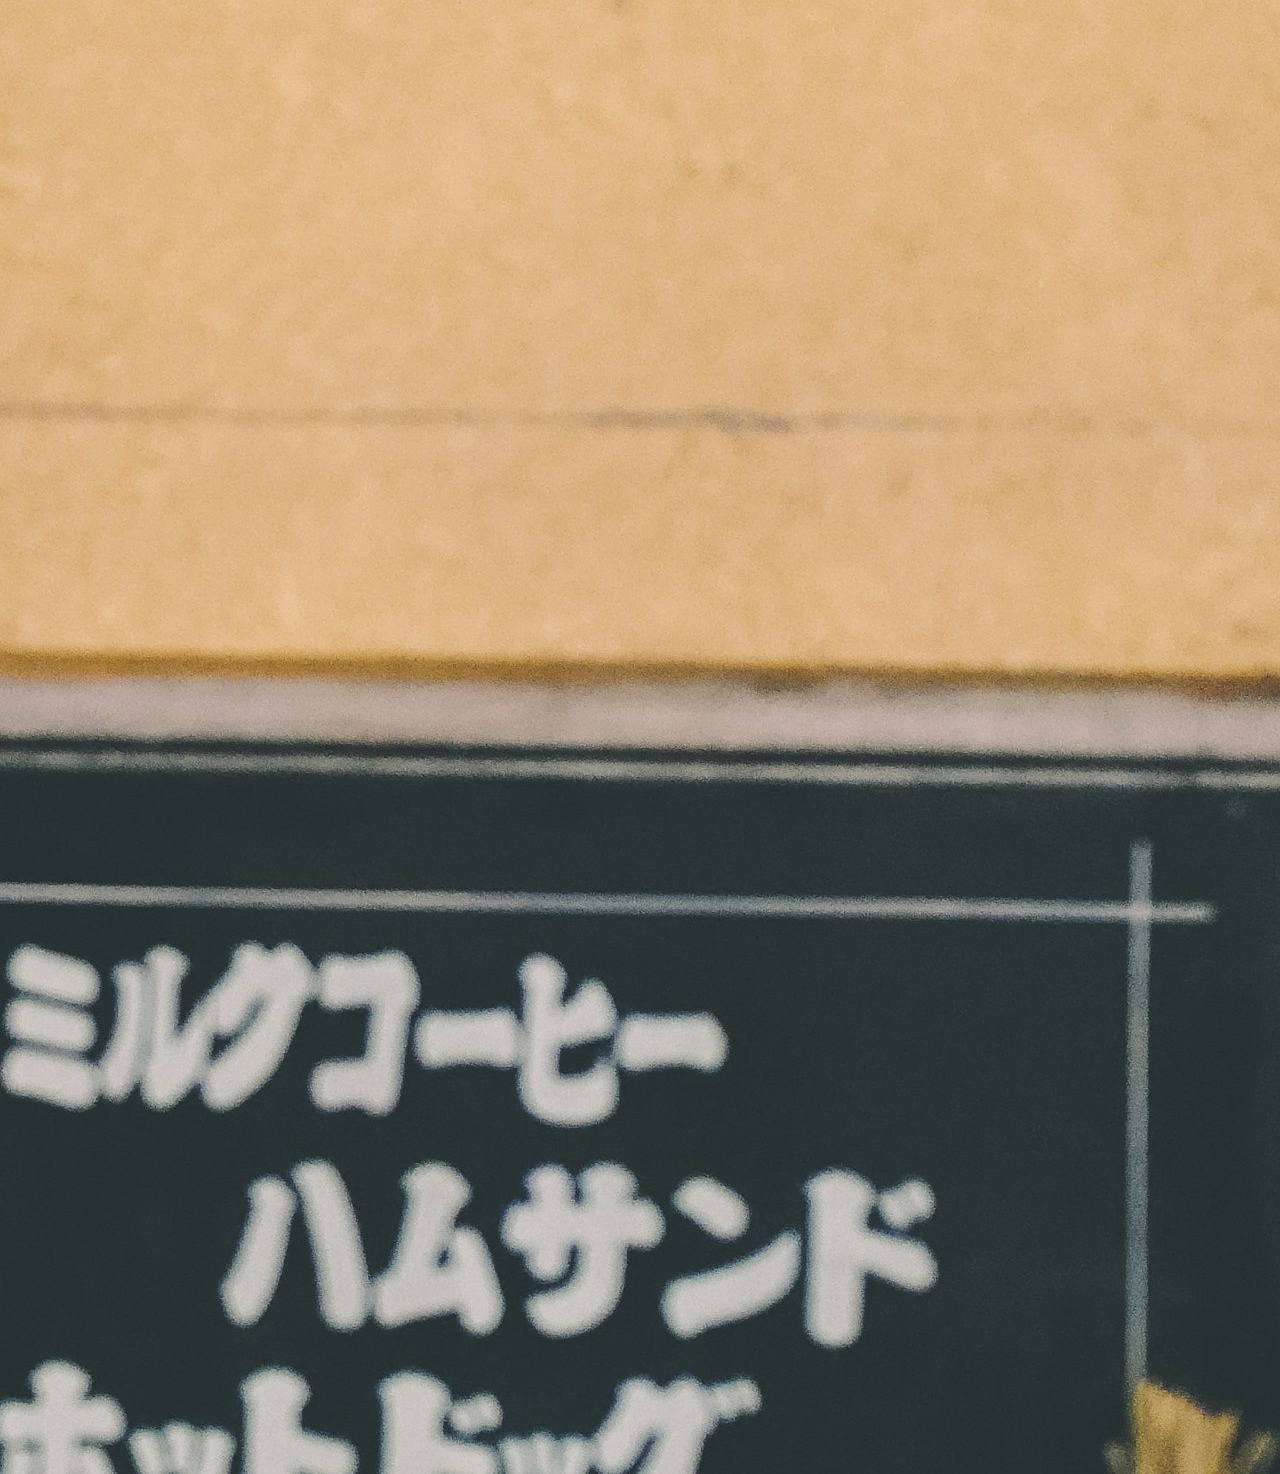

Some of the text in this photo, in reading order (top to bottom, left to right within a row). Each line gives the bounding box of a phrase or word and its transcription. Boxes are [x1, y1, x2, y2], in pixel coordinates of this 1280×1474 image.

[0, 942, 730, 1126] ミルクコーヒー
[222, 1160, 940, 1348] ハムサンド
